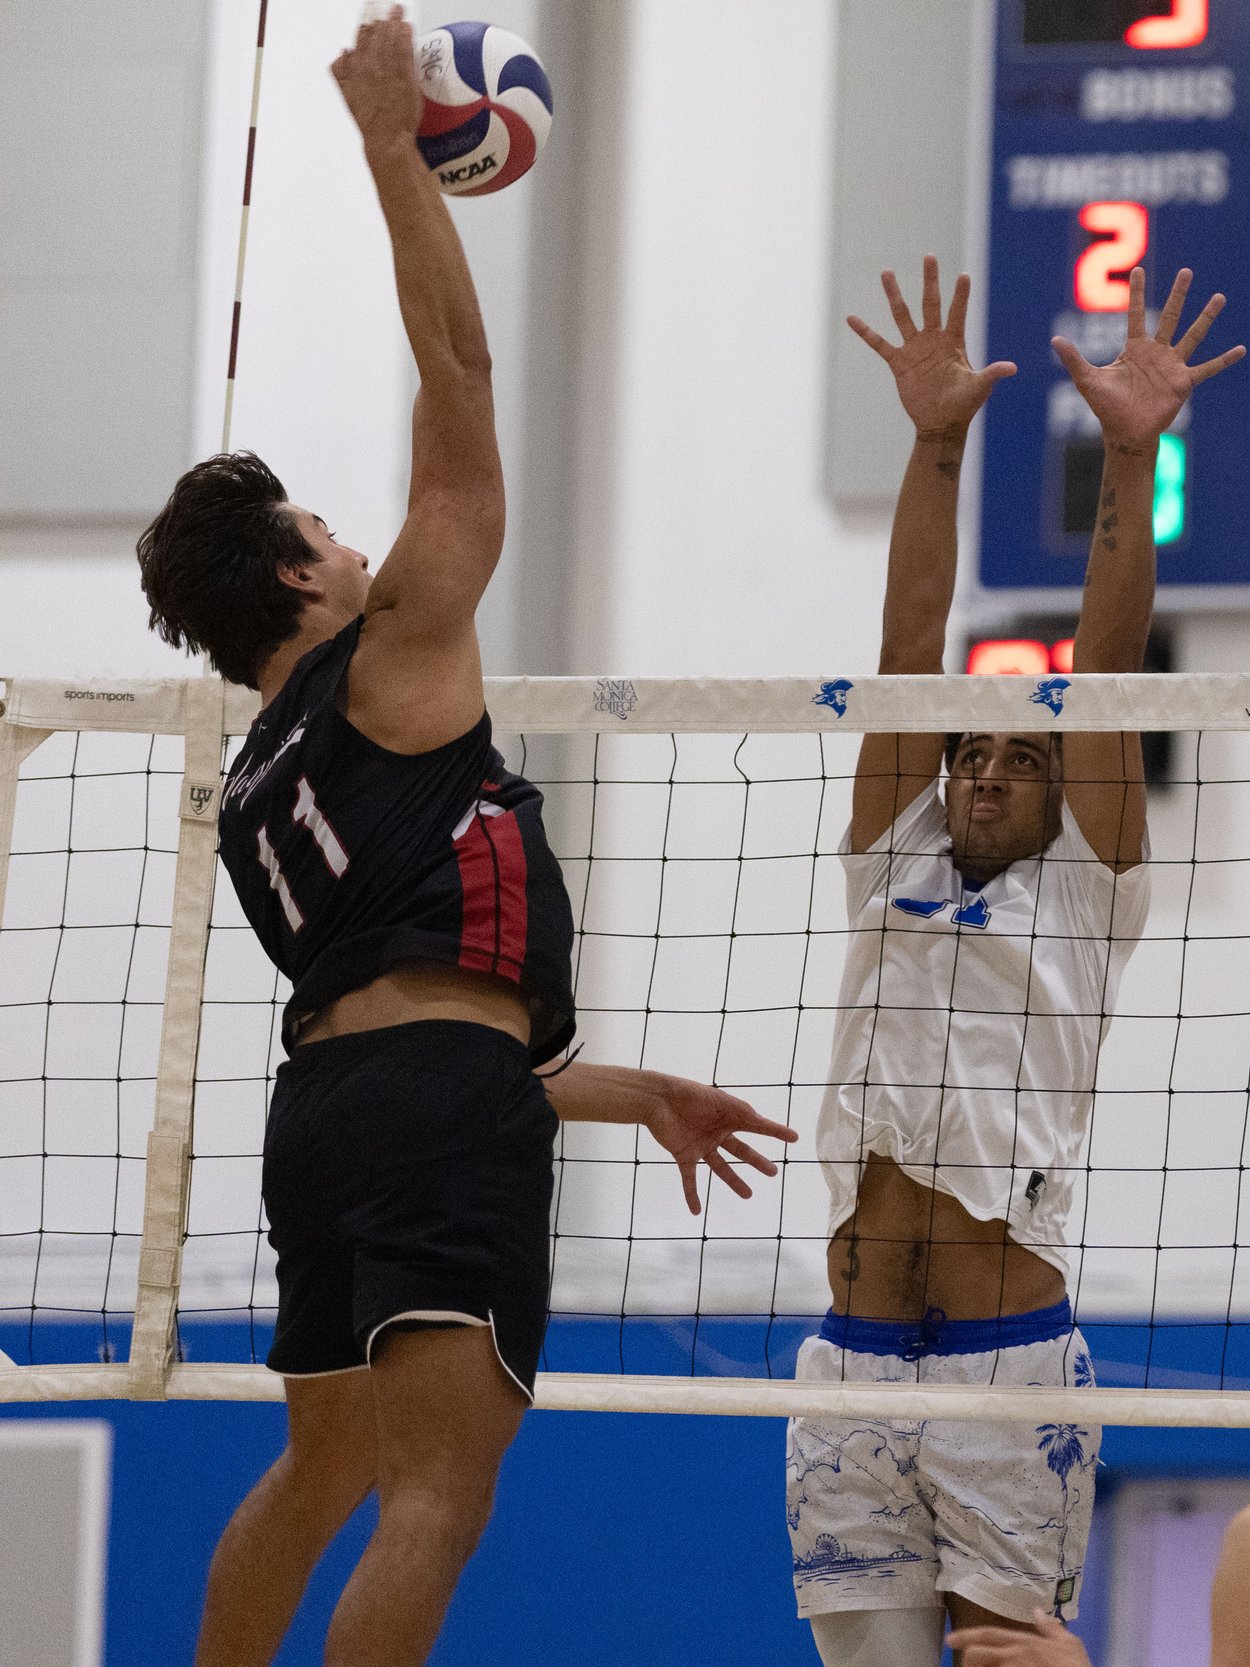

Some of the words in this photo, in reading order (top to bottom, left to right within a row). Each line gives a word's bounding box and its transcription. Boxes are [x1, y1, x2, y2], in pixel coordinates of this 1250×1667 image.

[1082, 66, 1234, 121] BONUS
[438, 154, 497, 185] NCAA
[1008, 150, 1230, 207] TIMEOUTS
[1075, 200, 1149, 312] 2
[64, 690, 95, 701] sports
[593, 690, 639, 701] MONICA
[596, 677, 635, 690] SANTA
[594, 701, 636, 720] COLLEGE
[257, 775, 349, 935] 11
